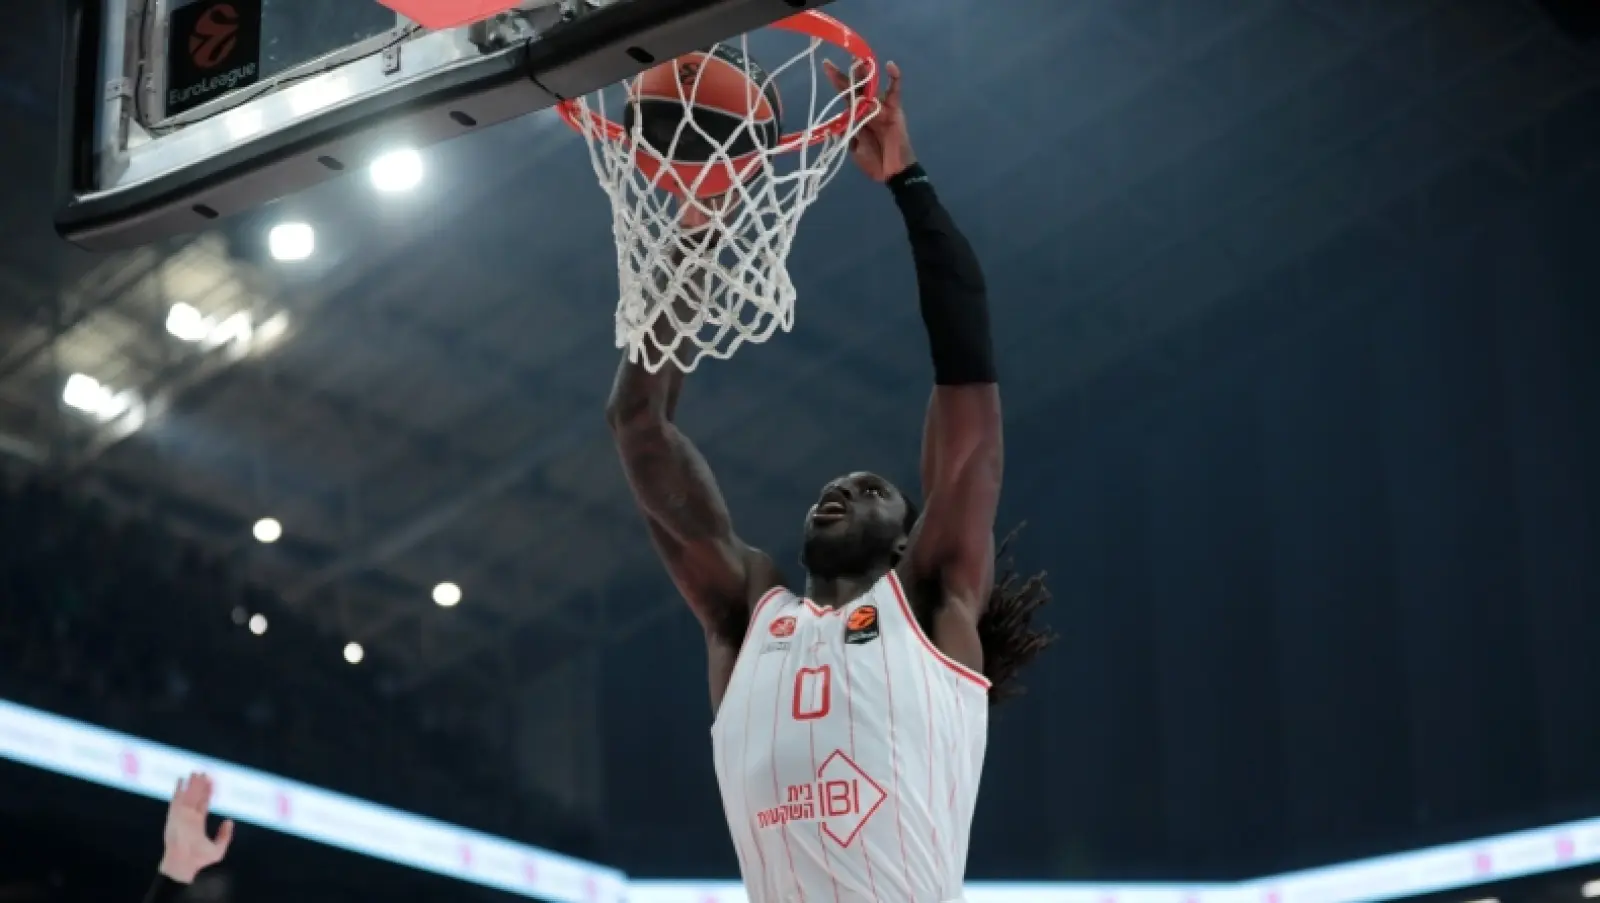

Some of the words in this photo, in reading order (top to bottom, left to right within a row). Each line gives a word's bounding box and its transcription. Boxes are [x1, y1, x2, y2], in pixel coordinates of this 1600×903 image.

[169, 62, 256, 105] EuroLeague
[792, 664, 830, 720] 0
[787, 783, 813, 802] בית
[817, 779, 859, 816] IBI
